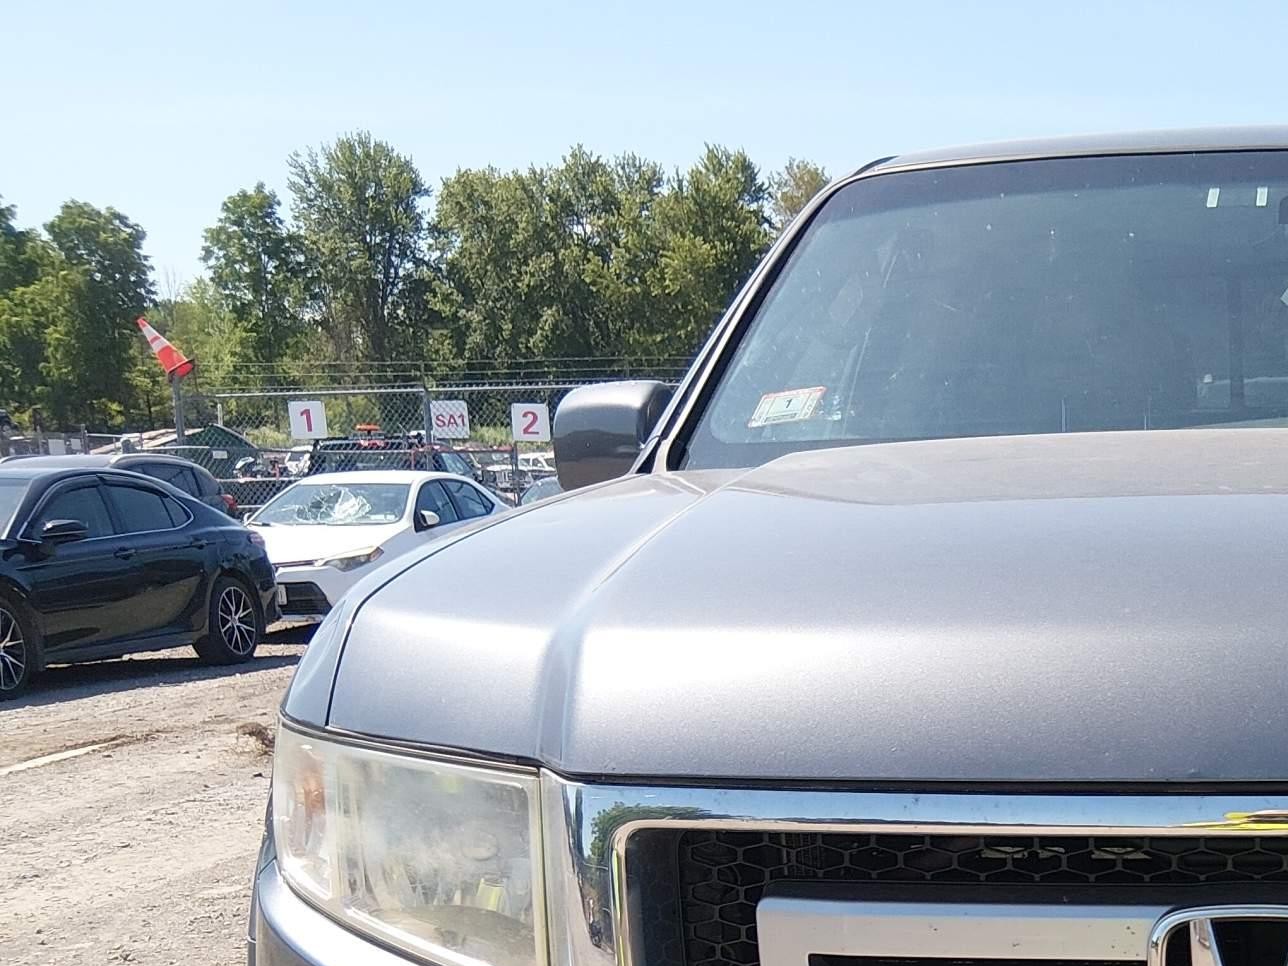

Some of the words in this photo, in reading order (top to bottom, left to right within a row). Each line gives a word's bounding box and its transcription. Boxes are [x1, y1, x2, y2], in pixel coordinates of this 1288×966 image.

[300, 408, 313, 432] 1
[434, 414, 465, 428] SA1
[521, 410, 540, 435] 2
